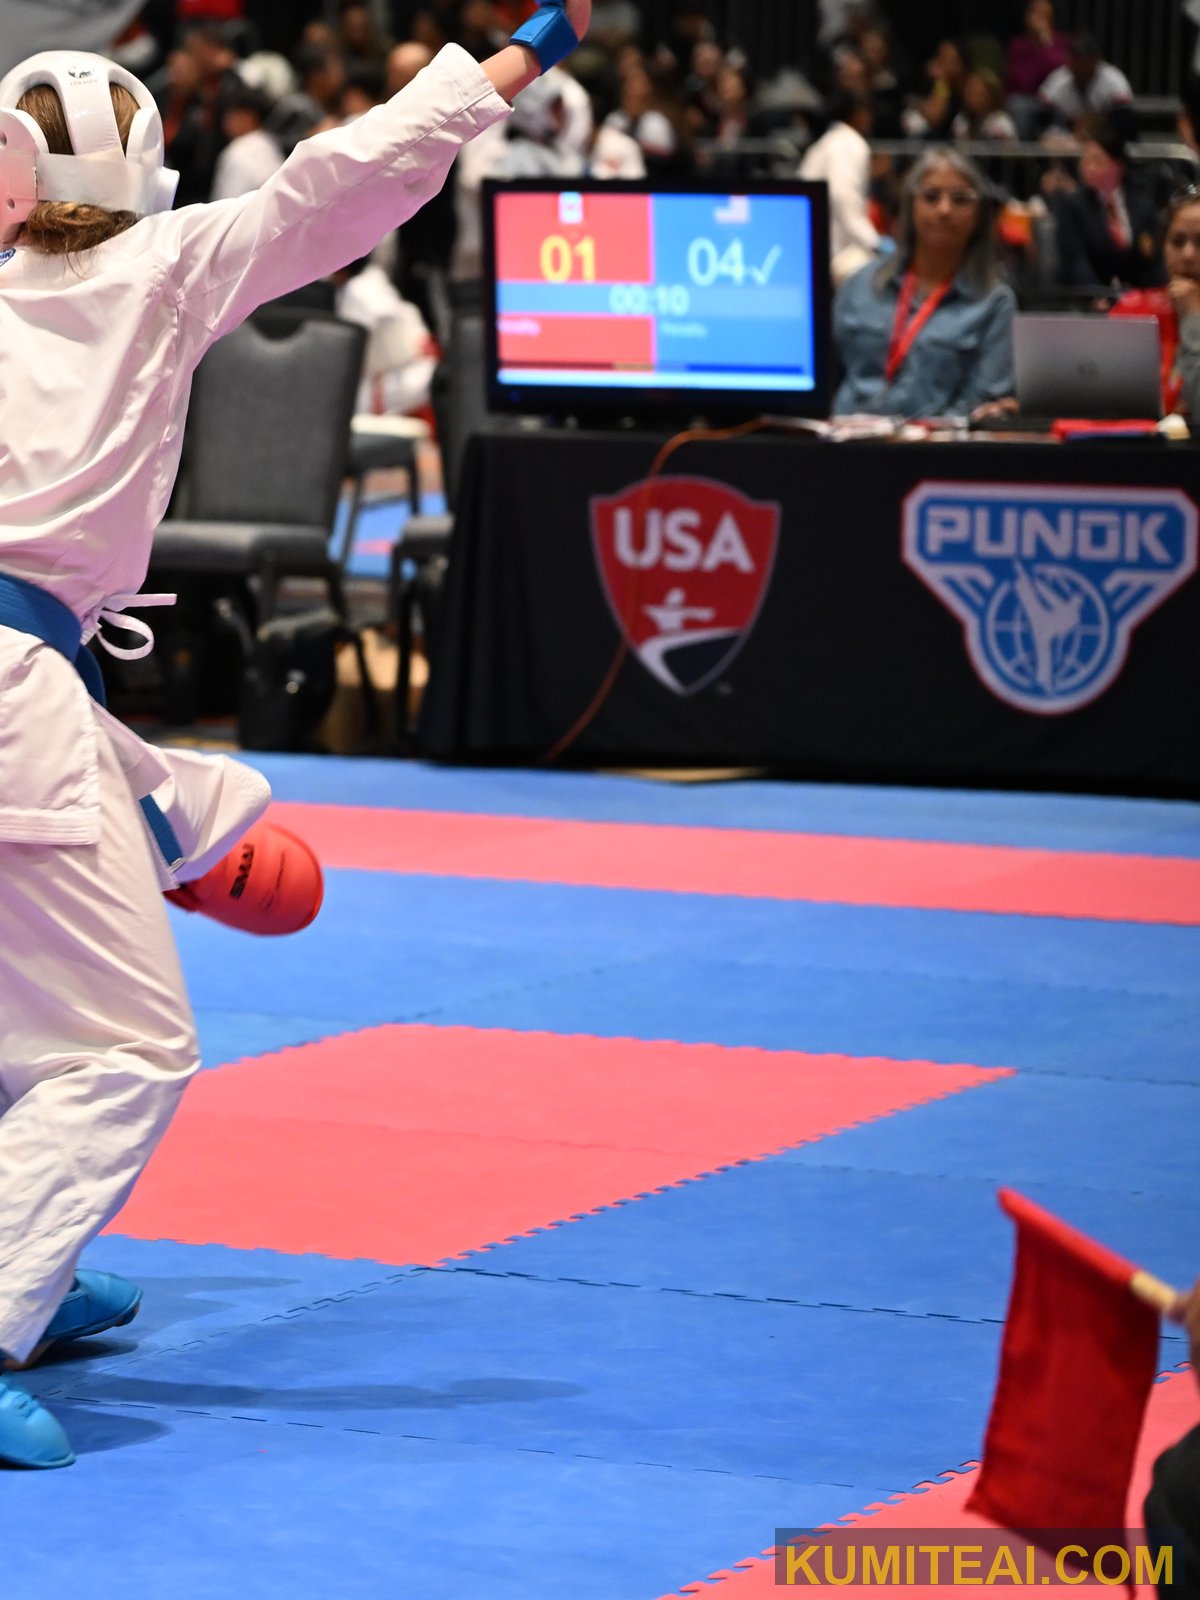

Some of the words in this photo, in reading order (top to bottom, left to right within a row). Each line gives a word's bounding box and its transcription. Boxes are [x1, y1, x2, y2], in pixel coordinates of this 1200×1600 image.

[539, 235, 595, 284] 01
[687, 237, 745, 286] 04
[608, 284, 690, 317] 00:10
[614, 507, 755, 574] USA
